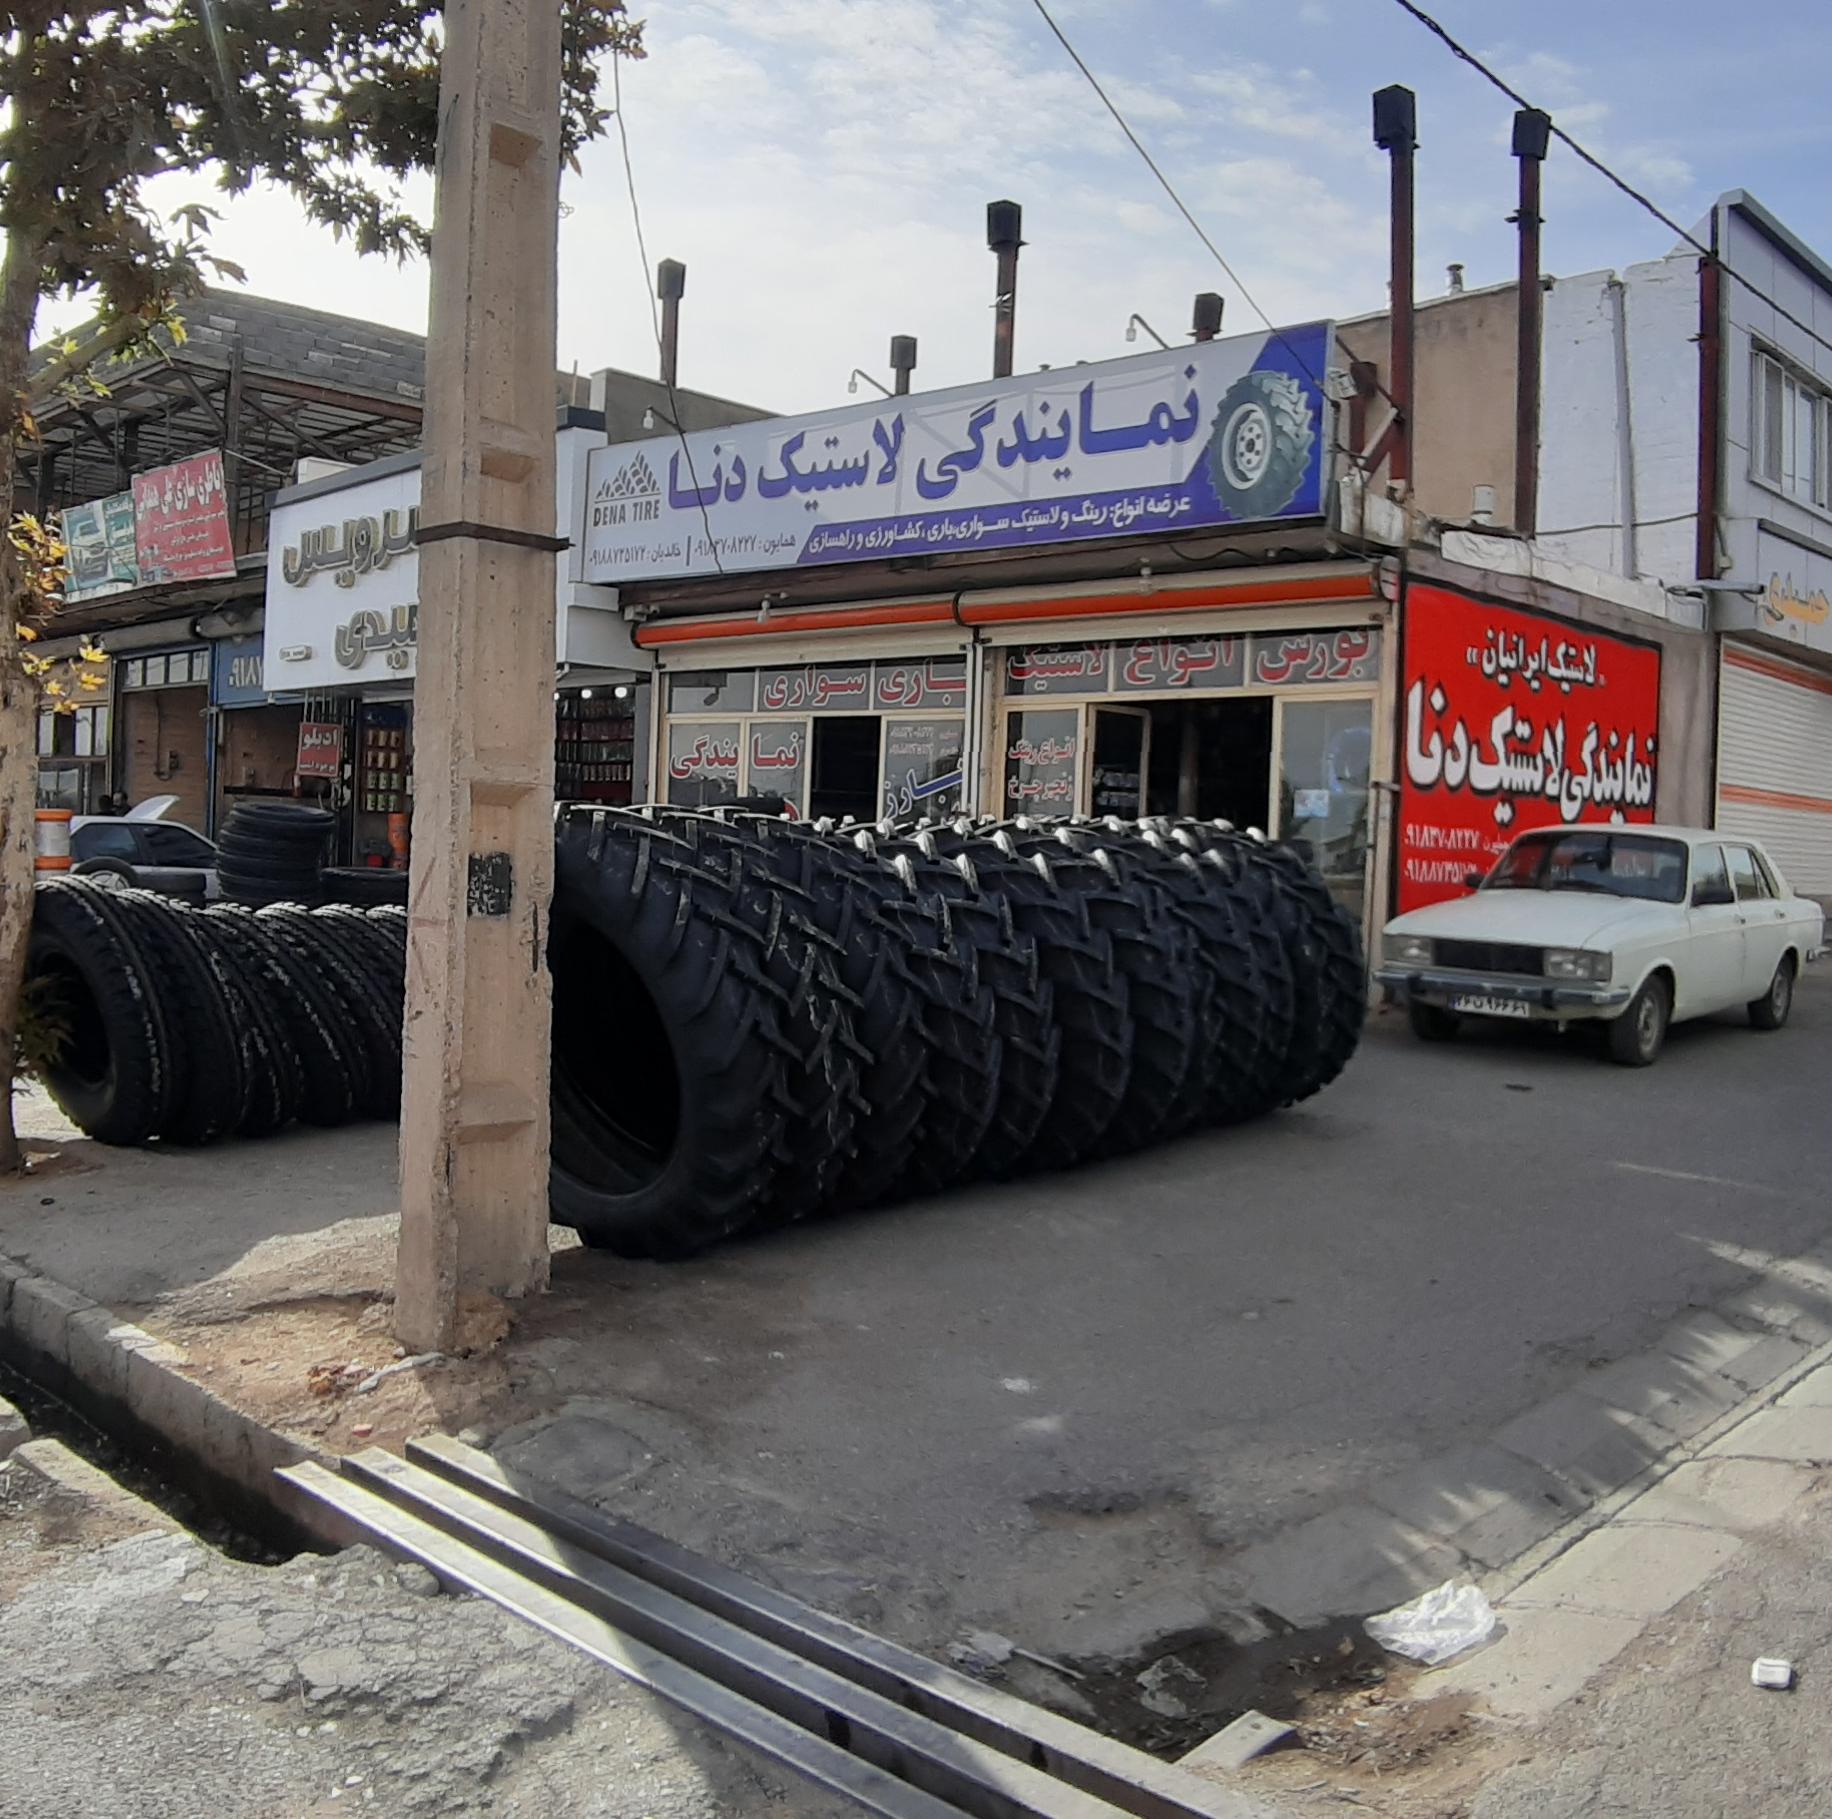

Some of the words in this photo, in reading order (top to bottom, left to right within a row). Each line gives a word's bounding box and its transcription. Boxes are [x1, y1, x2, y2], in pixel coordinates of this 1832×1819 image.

[916, 364, 1199, 500] نمایندگی
[668, 444, 746, 510] دنا
[757, 412, 904, 511] لاستیک
[593, 504, 626, 527] DENA
[633, 500, 660, 522] TIRE
[1012, 505, 1059, 531] لاستیک
[1072, 500, 1108, 525] رینگ
[1147, 493, 1191, 517] عرضه
[1007, 643, 1106, 690] لاستیک
[1124, 636, 1234, 685] انواع
[1257, 629, 1373, 683] بورس
[764, 664, 867, 709] سواری
[1406, 680, 1468, 786] دنا
[1469, 705, 1565, 824] لاستیک
[1560, 721, 1655, 824] نمایندگی
